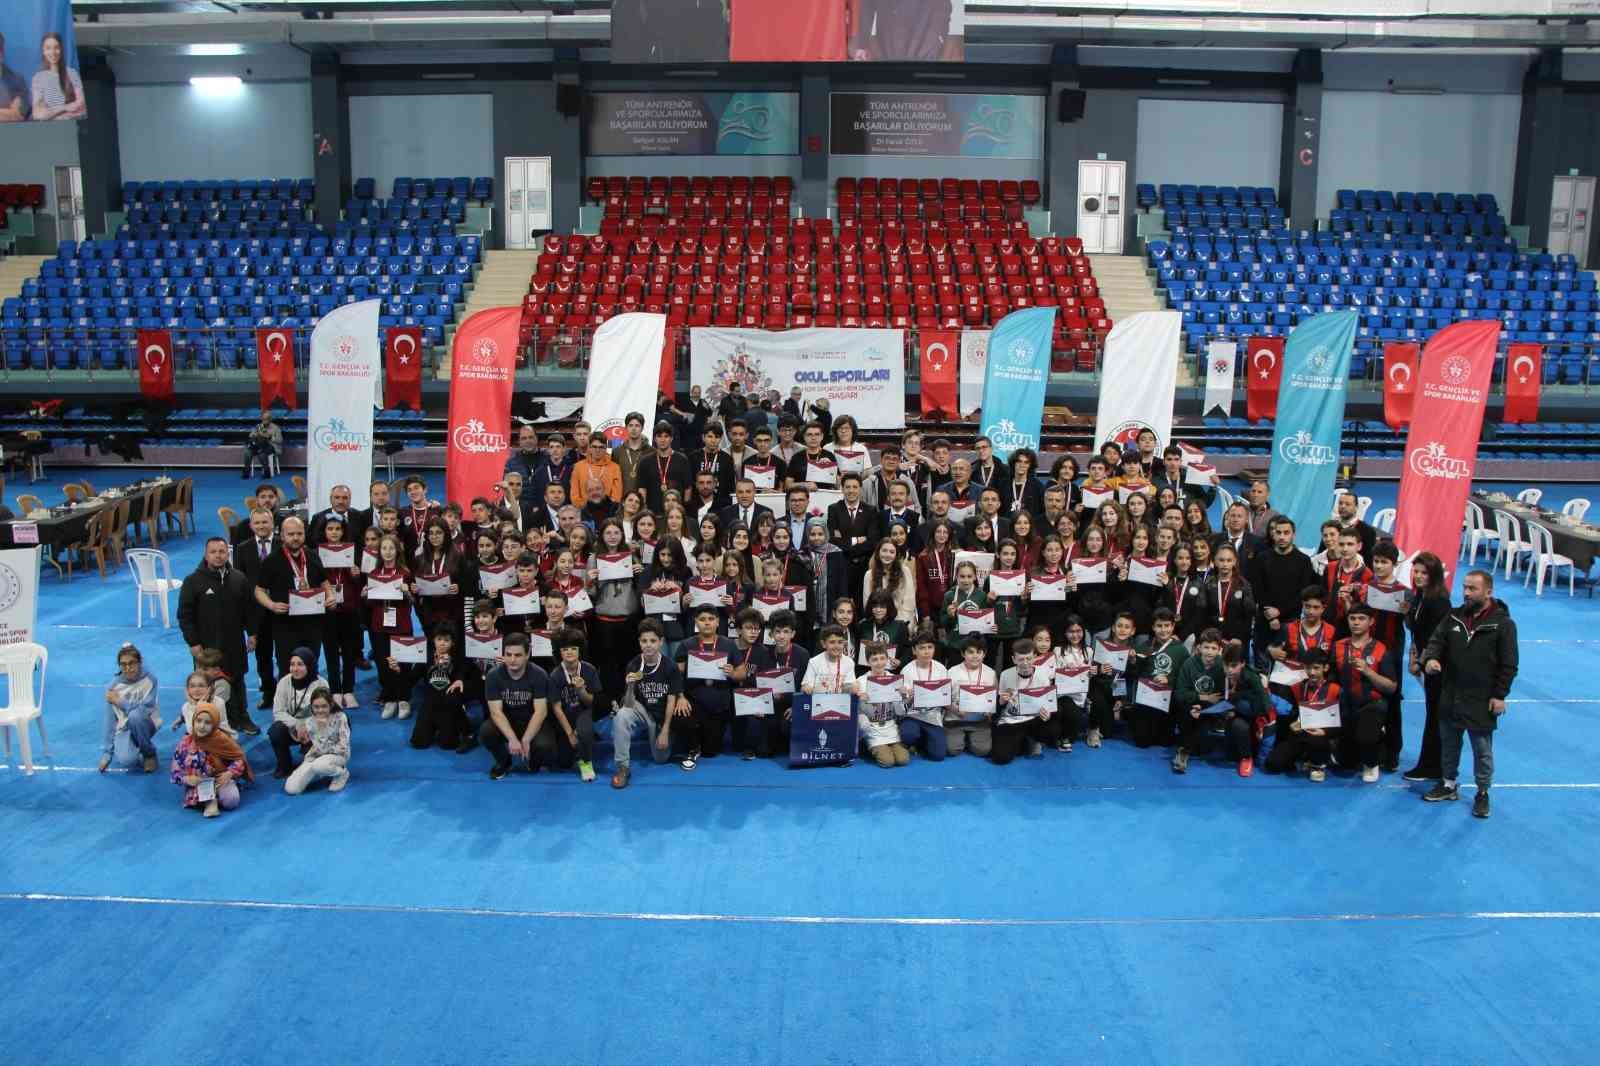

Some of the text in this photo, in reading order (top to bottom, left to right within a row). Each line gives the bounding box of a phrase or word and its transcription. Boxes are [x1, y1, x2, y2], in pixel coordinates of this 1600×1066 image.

[1300, 148, 1313, 166] C
[795, 368, 890, 383] OKUL SPORLARI
[462, 432, 507, 449] OKUL
[993, 432, 1036, 449] OKUL
[1287, 443, 1335, 462] OKUL
[1418, 455, 1470, 477] OKUL
[801, 752, 845, 760] BİLNET
